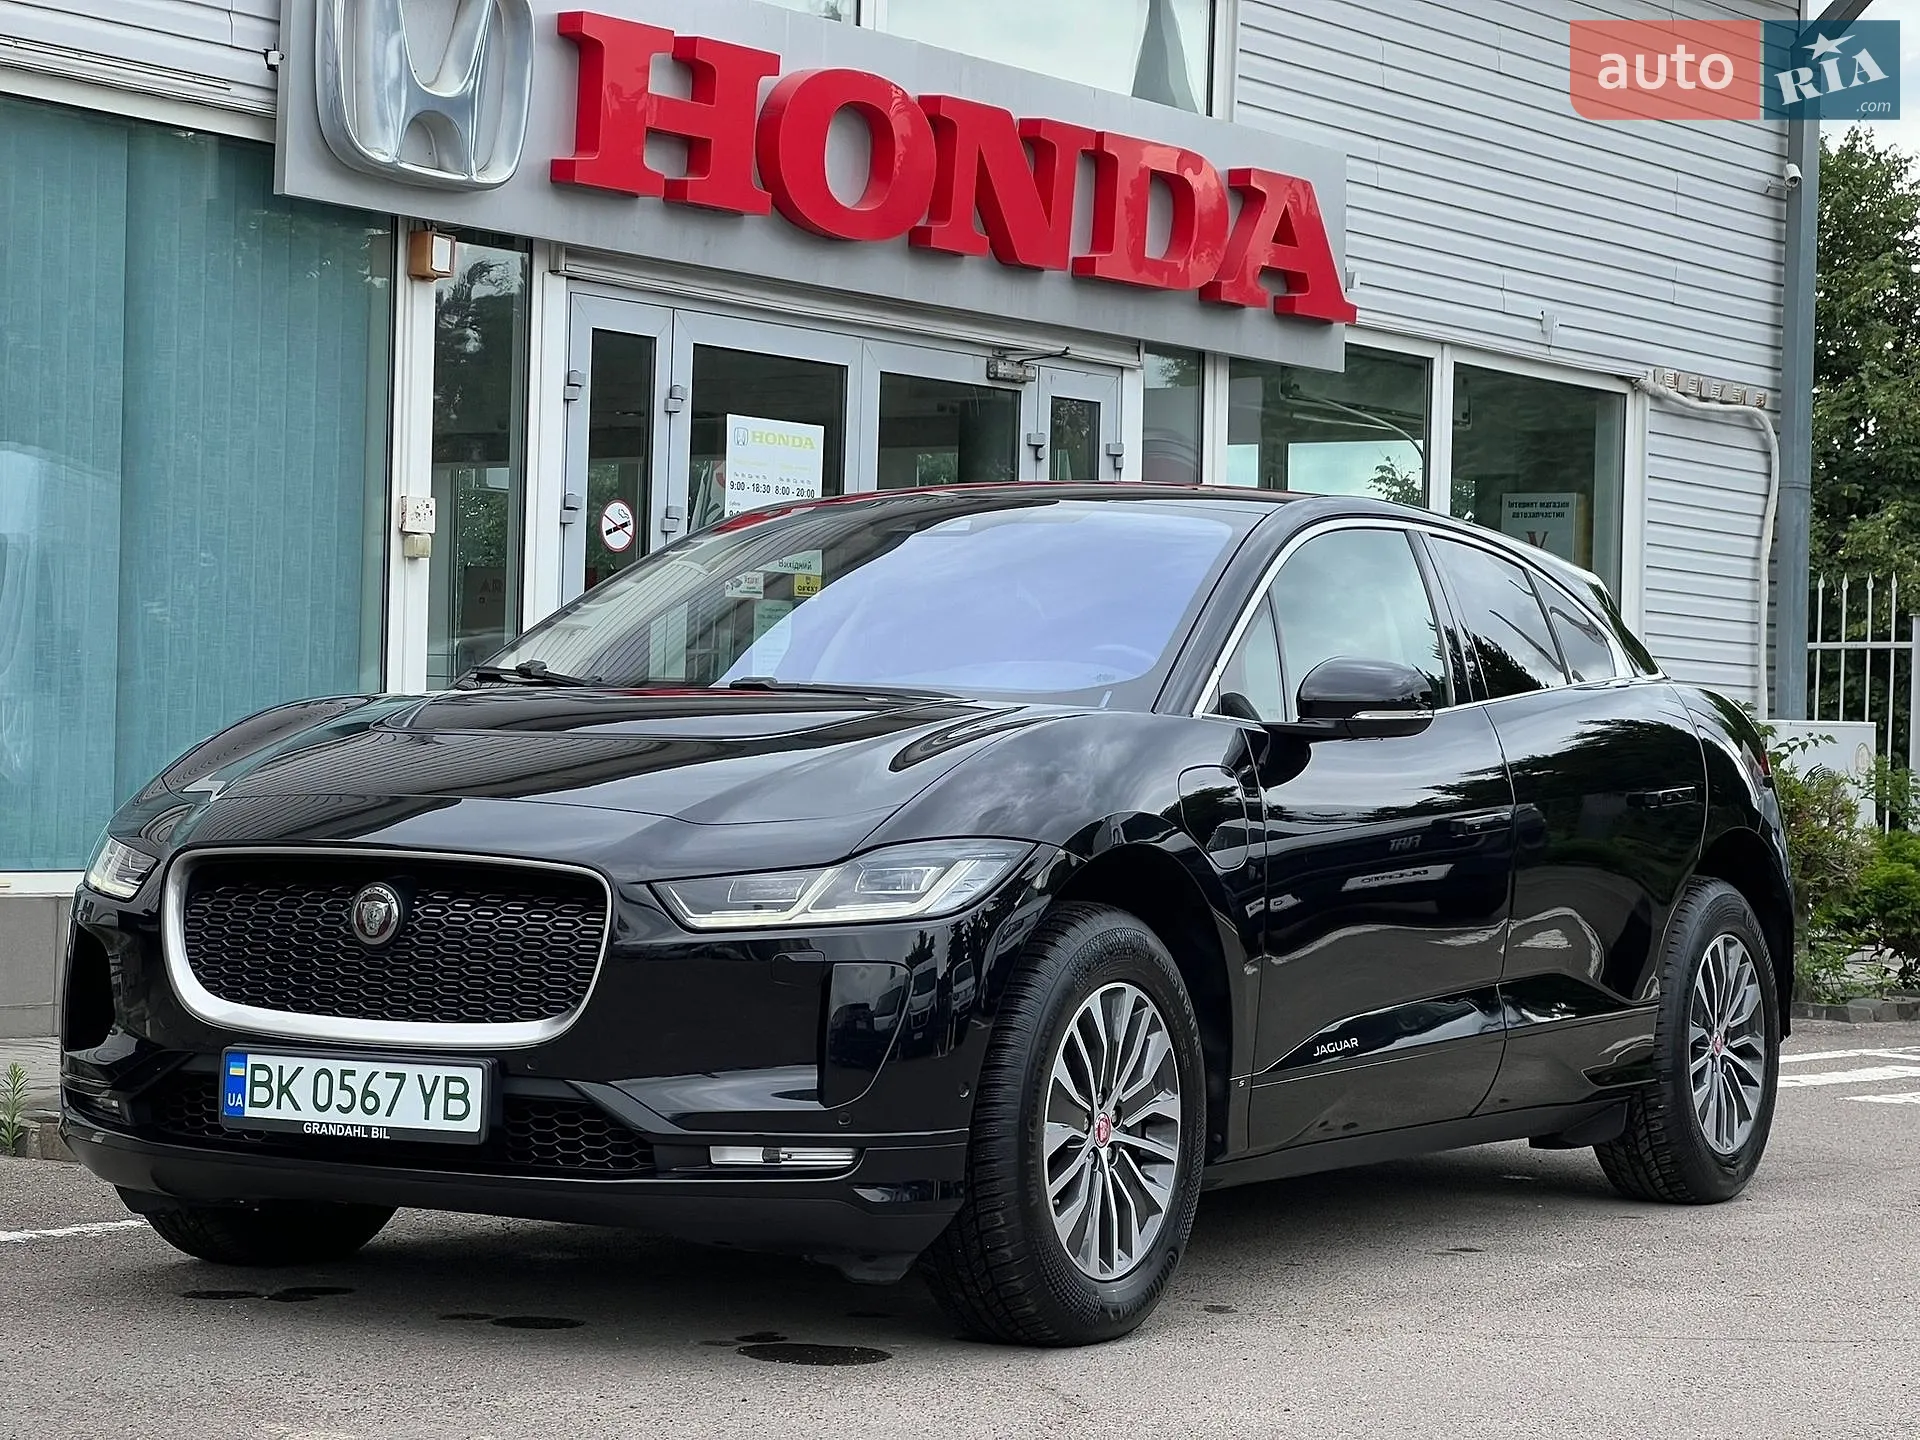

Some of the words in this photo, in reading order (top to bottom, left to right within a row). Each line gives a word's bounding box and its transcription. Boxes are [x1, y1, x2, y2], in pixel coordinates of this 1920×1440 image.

[550, 10, 1358, 325] HONDA
[751, 430, 815, 450] HONDA
[729, 481, 746, 491] 9:00
[752, 483, 771, 494] 18:30
[774, 485, 791, 496] 8:00
[796, 488, 815, 499] 20:00
[1313, 1037, 1359, 1056] JAGUAR
[227, 1093, 243, 1107] UA
[248, 1063, 304, 1112] BK
[312, 1067, 407, 1118] 0567
[417, 1073, 472, 1122] YB
[303, 1122, 368, 1139] GRANDAHL
[371, 1126, 391, 1140] BIL
